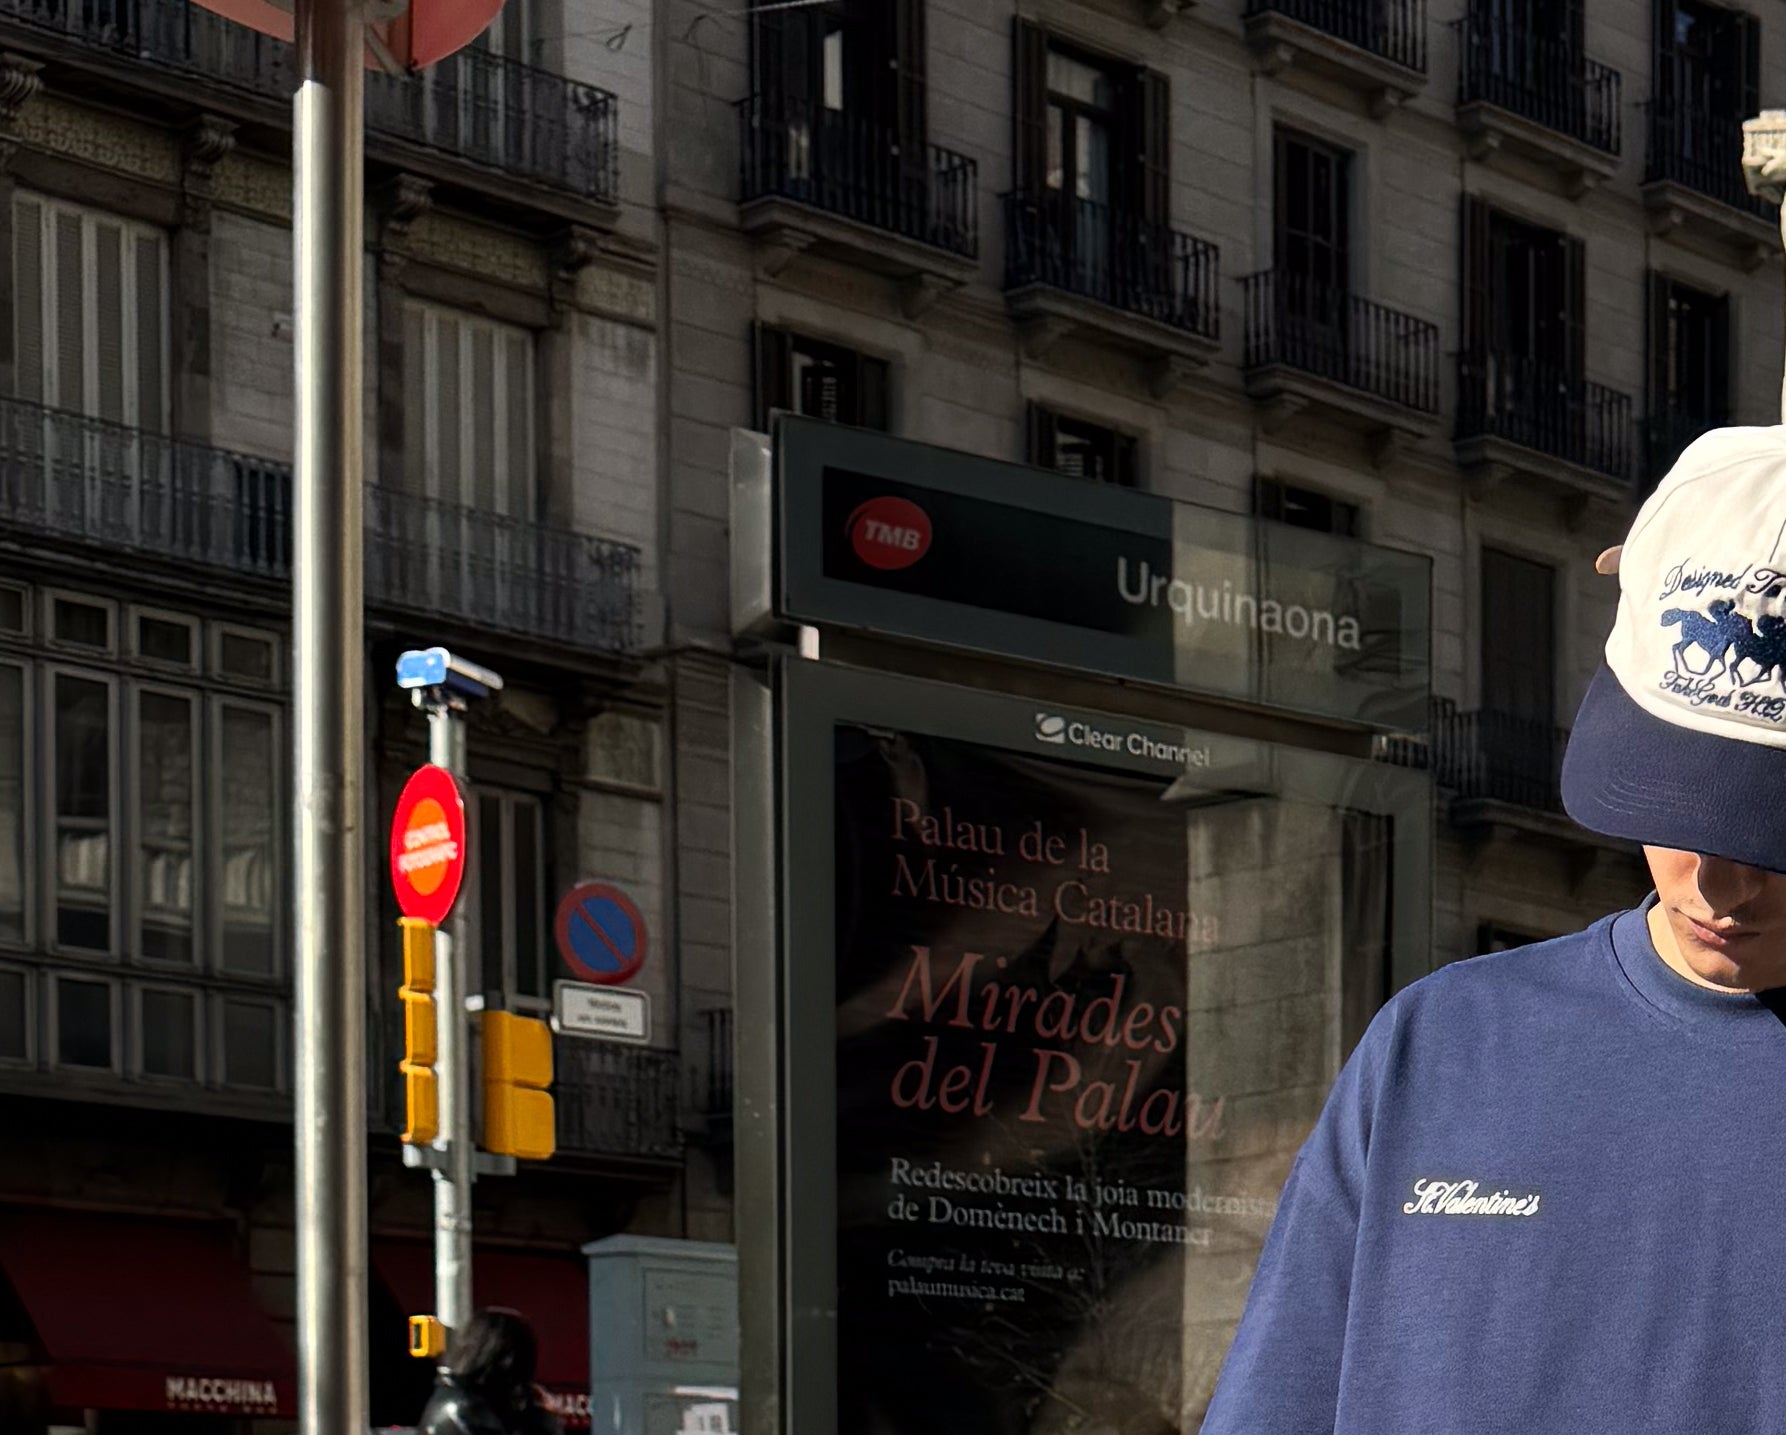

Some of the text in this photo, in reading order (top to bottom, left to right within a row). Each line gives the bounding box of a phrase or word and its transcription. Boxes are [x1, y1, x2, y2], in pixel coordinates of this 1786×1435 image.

[863, 518, 923, 551] TMB
[1117, 556, 1361, 650] Urquinaona
[1659, 557, 1753, 601] Designed
[1068, 722, 1211, 767] Clear Channel
[890, 798, 1110, 873] Palau de la
[890, 853, 1219, 944] Música Catalana
[887, 945, 1181, 1054] Mirades
[890, 1036, 1228, 1141] del Palau
[889, 1157, 1059, 1201] Redescobreix
[1065, 1174, 1090, 1203] la
[1091, 1179, 1139, 1210] joia
[888, 1193, 1212, 1247] de Domènech i Montaner
[165, 1375, 278, 1405] MACCHINA
